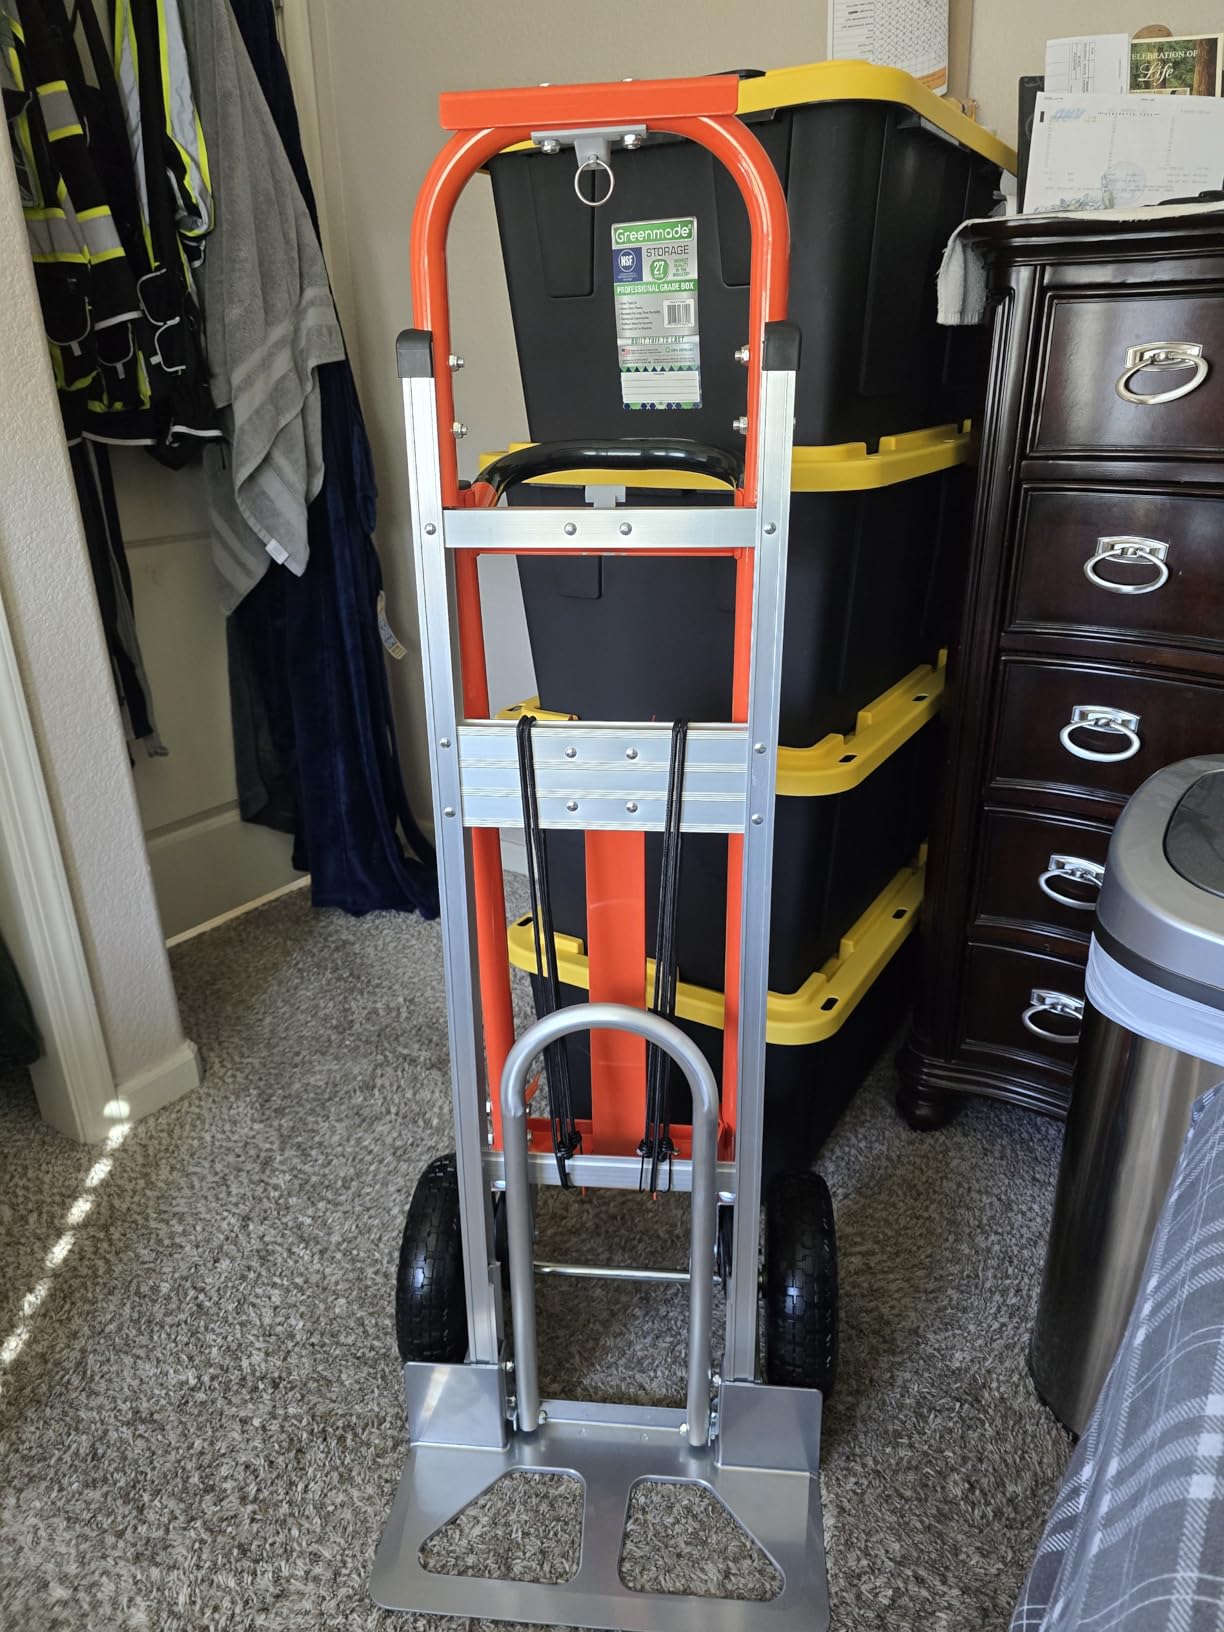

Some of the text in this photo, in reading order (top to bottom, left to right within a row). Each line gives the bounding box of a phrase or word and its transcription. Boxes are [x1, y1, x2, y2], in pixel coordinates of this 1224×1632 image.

[1131, 49, 1198, 60] ELEBRATION OF
[1138, 62, 1174, 85] Life
[616, 224, 690, 242] Greenmade
[646, 245, 689, 257] STORAGE
[621, 255, 633, 267] NSF
[654, 261, 665, 274] 27
[618, 282, 694, 294] PROFESSIONAL GRADE BOX
[671, 335, 685, 343] LAST
